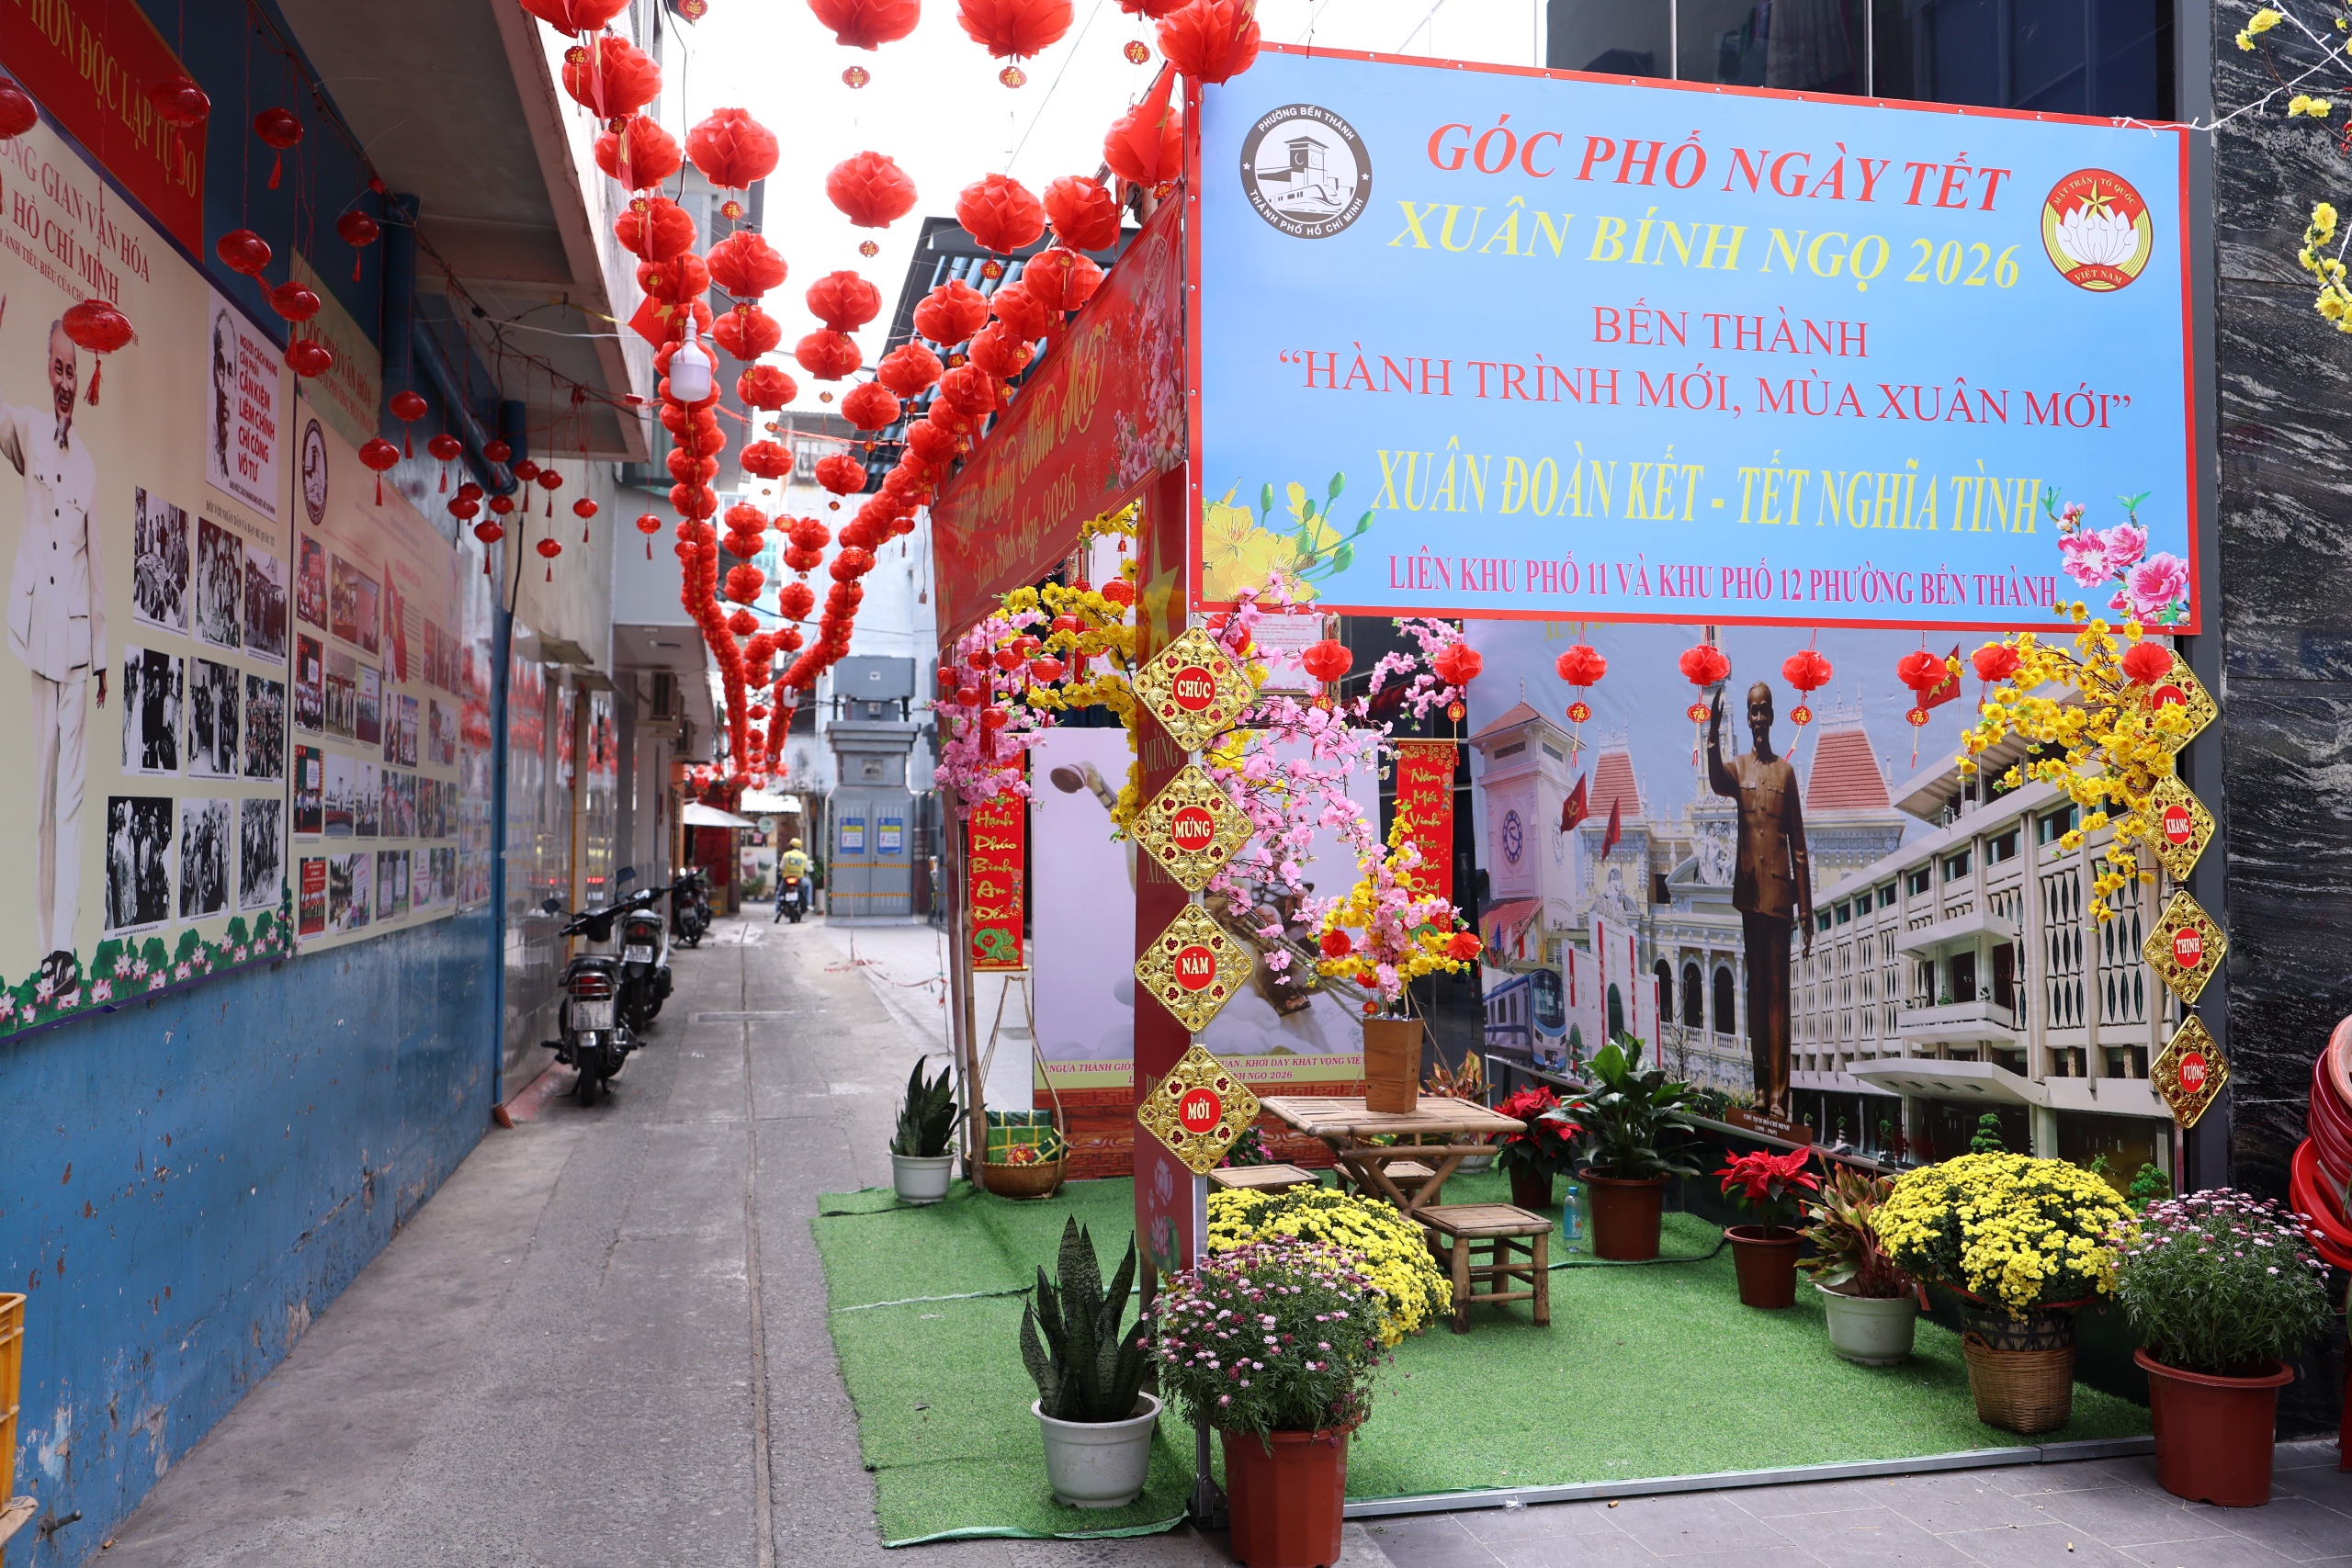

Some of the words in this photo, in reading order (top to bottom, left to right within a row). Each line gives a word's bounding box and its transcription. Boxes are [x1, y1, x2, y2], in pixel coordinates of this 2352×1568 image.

[570, 51, 584, 62] 福
[1130, 46, 1145, 60] 福
[79, 20, 118, 110] ĐỘC
[121, 69, 152, 151] LẬP
[1006, 71, 1020, 85] 福
[1258, 107, 1297, 132] PHƯỜNG
[1300, 106, 1322, 118] BẾN
[1324, 112, 1355, 141] THÀNH
[1427, 114, 1563, 178] GÓC
[1574, 130, 1707, 189] PHỐ
[1721, 141, 1891, 203] NGÀY
[1903, 151, 2012, 212] TẾT
[2053, 187, 2069, 206] MẶT
[2068, 175, 2094, 190] TRẬN
[2100, 177, 2113, 187] TỔ
[2114, 184, 2136, 206] QUỐC
[635, 201, 646, 211] 福
[726, 204, 738, 216] 福
[1250, 188, 1278, 223] THÀNH
[1279, 220, 1303, 234] PHỐ
[1306, 224, 1322, 236] HỒ
[1326, 217, 1343, 232] CHÍ
[1342, 197, 1363, 222] MINH
[41, 162, 83, 224] GIAN
[120, 236, 151, 284] HÓA
[13, 188, 40, 240] HỒ
[44, 218, 75, 270] CHÍ
[78, 245, 119, 305] MINH
[863, 243, 875, 254] 福
[1386, 196, 1576, 259] XUÂN
[1584, 206, 1748, 272] BÍNH
[1764, 227, 1890, 292] NGỌ
[1904, 238, 2021, 288] 2026
[985, 263, 998, 276] 福
[2075, 268, 2098, 282] VIỆT
[2100, 269, 2123, 285] NAM
[1590, 297, 1689, 346] BẾN
[1702, 305, 1871, 358] THÀNH
[951, 355, 962, 367] 福
[1278, 341, 1454, 397] “HÀNH
[1467, 353, 1623, 405] TRÌNH
[1636, 362, 1743, 419] MỚI,
[1756, 368, 1866, 419] MÙA
[1877, 377, 2009, 425] XUÂN
[2022, 381, 2132, 430] MỚI”
[254, 382, 270, 412] KIỆM
[1020, 382, 1056, 485] Năm
[1058, 322, 1106, 446] Mới
[239, 397, 254, 427] LIÊM
[254, 410, 275, 442] CHÍNH
[238, 425, 250, 450] CHÍ
[251, 434, 269, 464] CÔNG
[237, 452, 248, 476] VÔ
[248, 459, 258, 483] TƯ
[1371, 434, 1493, 514] XUÂN
[1498, 440, 1617, 518] ĐOÀN
[1623, 444, 1705, 522] KẾT
[1711, 497, 1725, 509] -
[1736, 449, 1811, 526] TẾT
[1816, 457, 1939, 530] NGHĨA
[1950, 458, 2043, 534] TÌNH
[996, 519, 1017, 578] Bính
[1018, 496, 1039, 566] Ngọ
[1043, 463, 1077, 536] 2026
[1388, 545, 1453, 592] LIÊN
[1459, 557, 1518, 593] KHU
[1525, 550, 1580, 595] PHỐ
[1588, 563, 1610, 595] 11
[1614, 553, 1651, 597] VÀ
[1657, 564, 1714, 599] KHU
[1720, 557, 1772, 601] PHỐ
[1780, 568, 1802, 602] 12
[1810, 560, 1915, 604] PHƯỜNG
[1920, 563, 1968, 606] BẾN
[1973, 565, 2058, 608] THÀNH
[1176, 675, 1212, 701] CHÚC
[1317, 696, 1329, 709] 福
[1572, 708, 1586, 718] 福
[1692, 707, 1705, 720] 福
[1794, 709, 1807, 721] 福
[1911, 711, 1924, 722] 福
[1410, 766, 1442, 785] Năm
[1412, 789, 1439, 807] Mới
[975, 810, 1014, 829] Hạnh
[1174, 816, 1211, 839] MỪNG
[1409, 810, 1442, 827] Vinh
[2165, 818, 2189, 834] KHANG
[974, 834, 1017, 852] Phúc
[1412, 833, 1438, 851] Hoa
[970, 857, 1013, 874] Bình
[976, 880, 1008, 898] An
[974, 904, 1010, 921] Đến
[2176, 937, 2200, 957] THỊNH
[1182, 953, 1209, 976] NĂM
[1079, 1062, 1112, 1073] THÁNH
[1245, 1057, 1269, 1067] KHƠI
[1271, 1058, 1290, 1068] DẬY
[1292, 1056, 1318, 1066] KHÁT
[1320, 1057, 1344, 1066] VỌNG
[2183, 1062, 2205, 1084] VƯỢNG
[1248, 1072, 1268, 1081] NGỌ
[1270, 1071, 1293, 1079] 2026
[1187, 1098, 1211, 1120] MỚI
